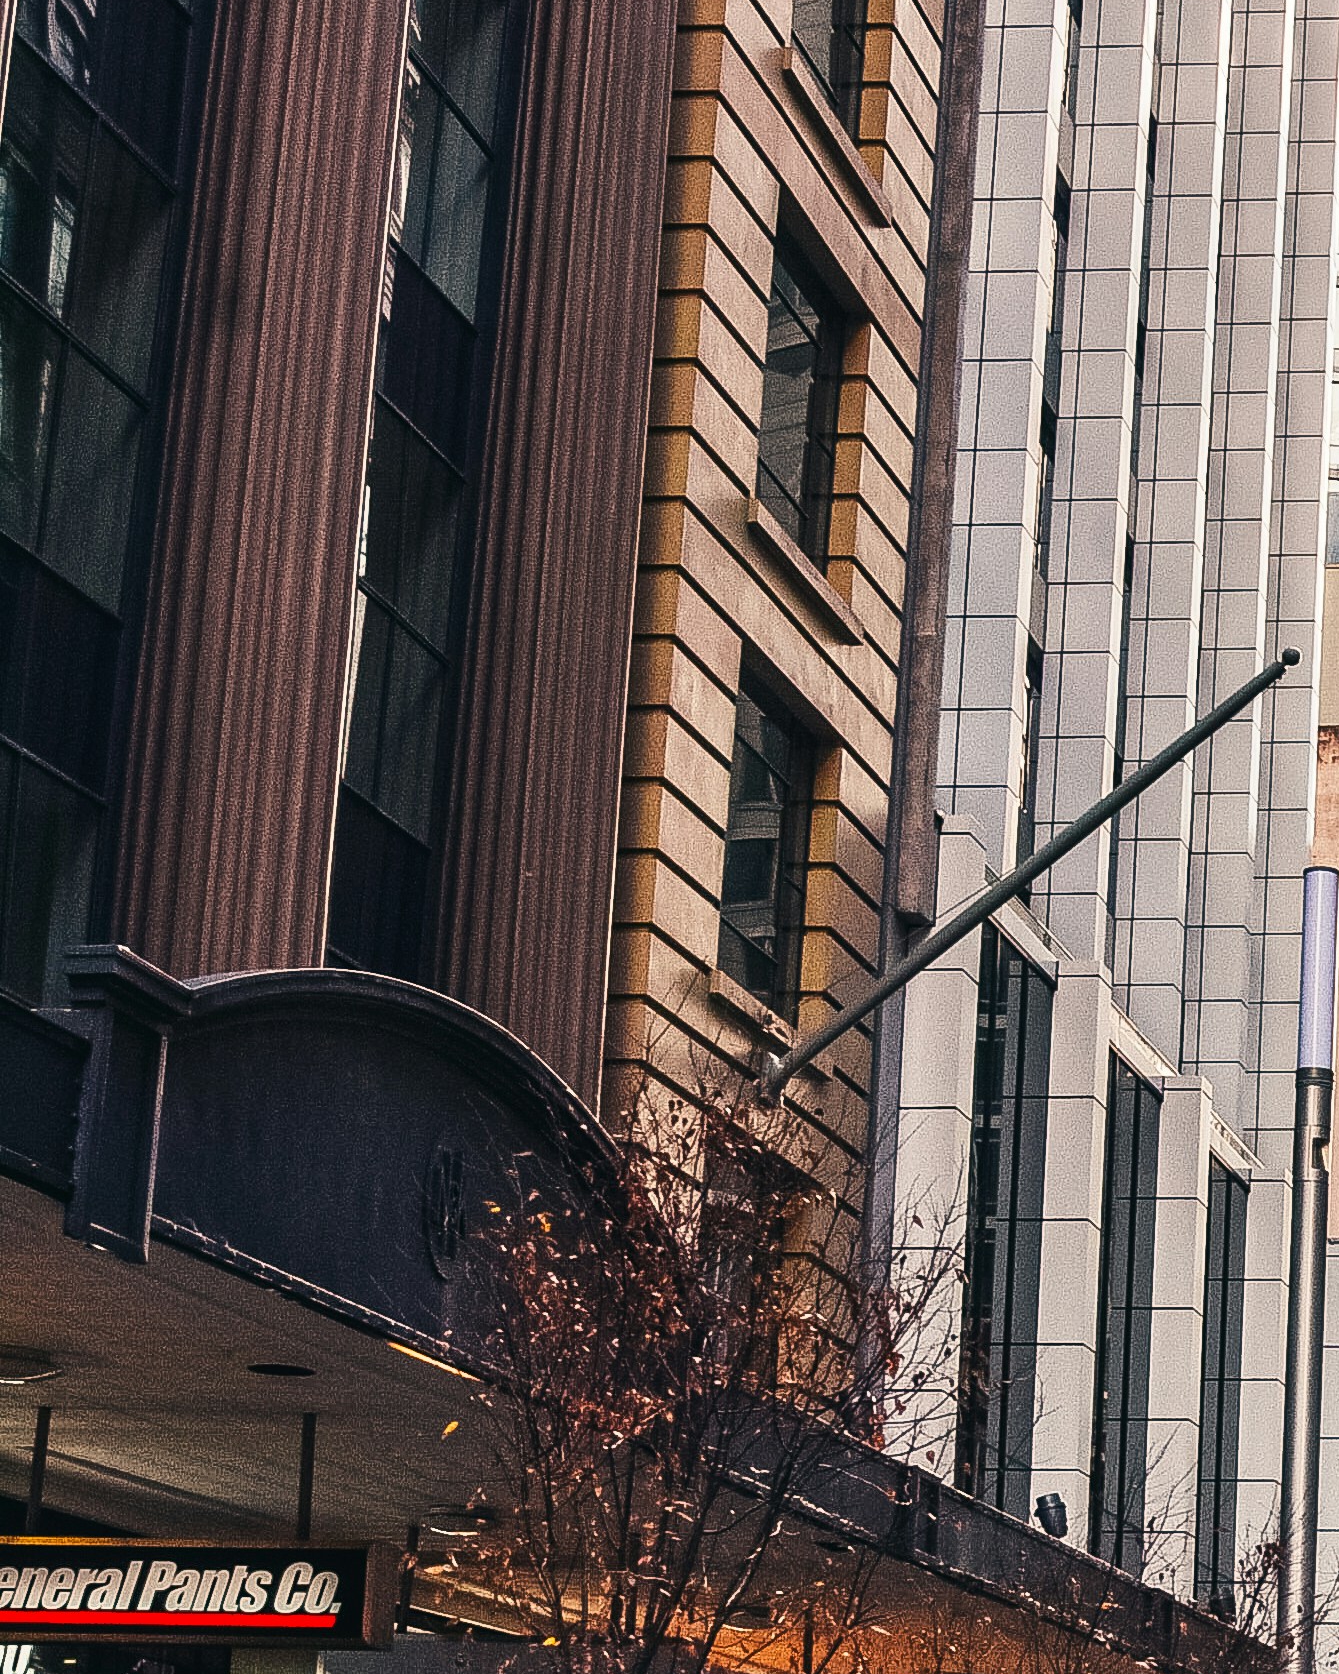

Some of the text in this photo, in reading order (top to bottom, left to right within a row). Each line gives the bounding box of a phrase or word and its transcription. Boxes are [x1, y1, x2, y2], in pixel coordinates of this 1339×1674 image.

[0, 1560, 342, 1614] eneral Pants Co.
